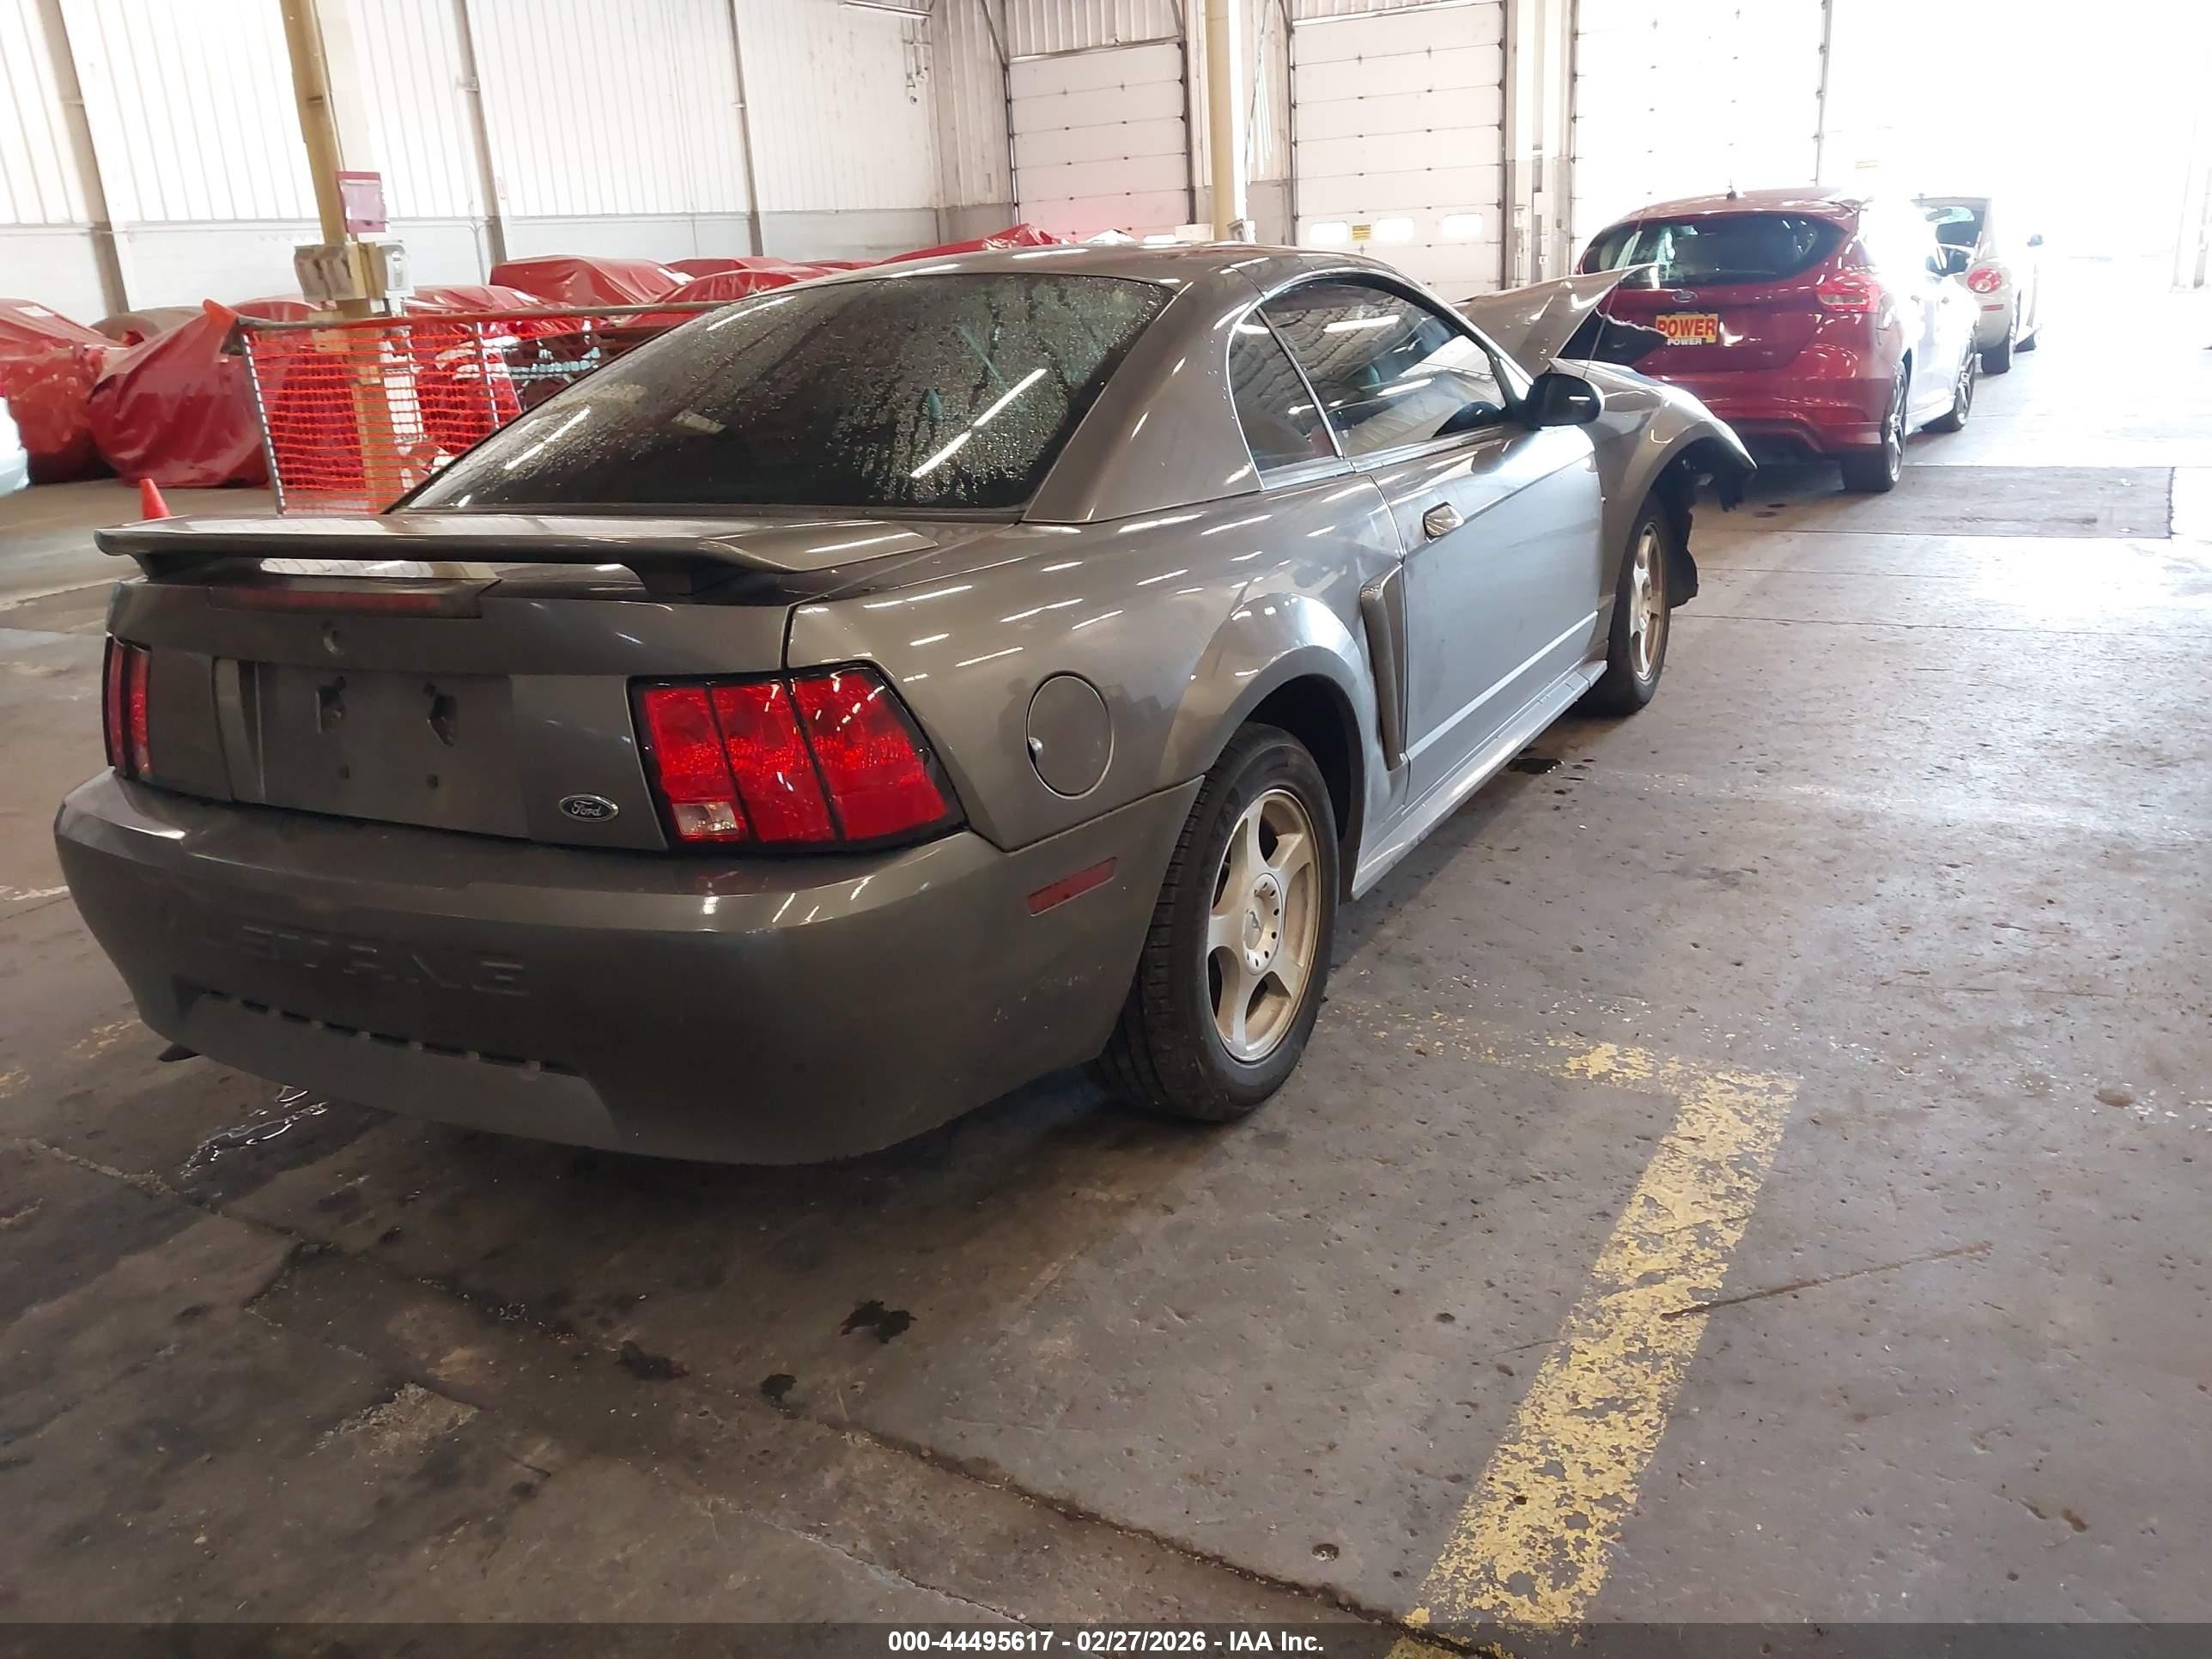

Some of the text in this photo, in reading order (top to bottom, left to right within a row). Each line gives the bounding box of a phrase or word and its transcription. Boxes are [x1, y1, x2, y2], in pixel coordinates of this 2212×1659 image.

[1657, 319, 1716, 337] POWER
[1667, 337, 1702, 346] POWER
[571, 800, 603, 817] Ford
